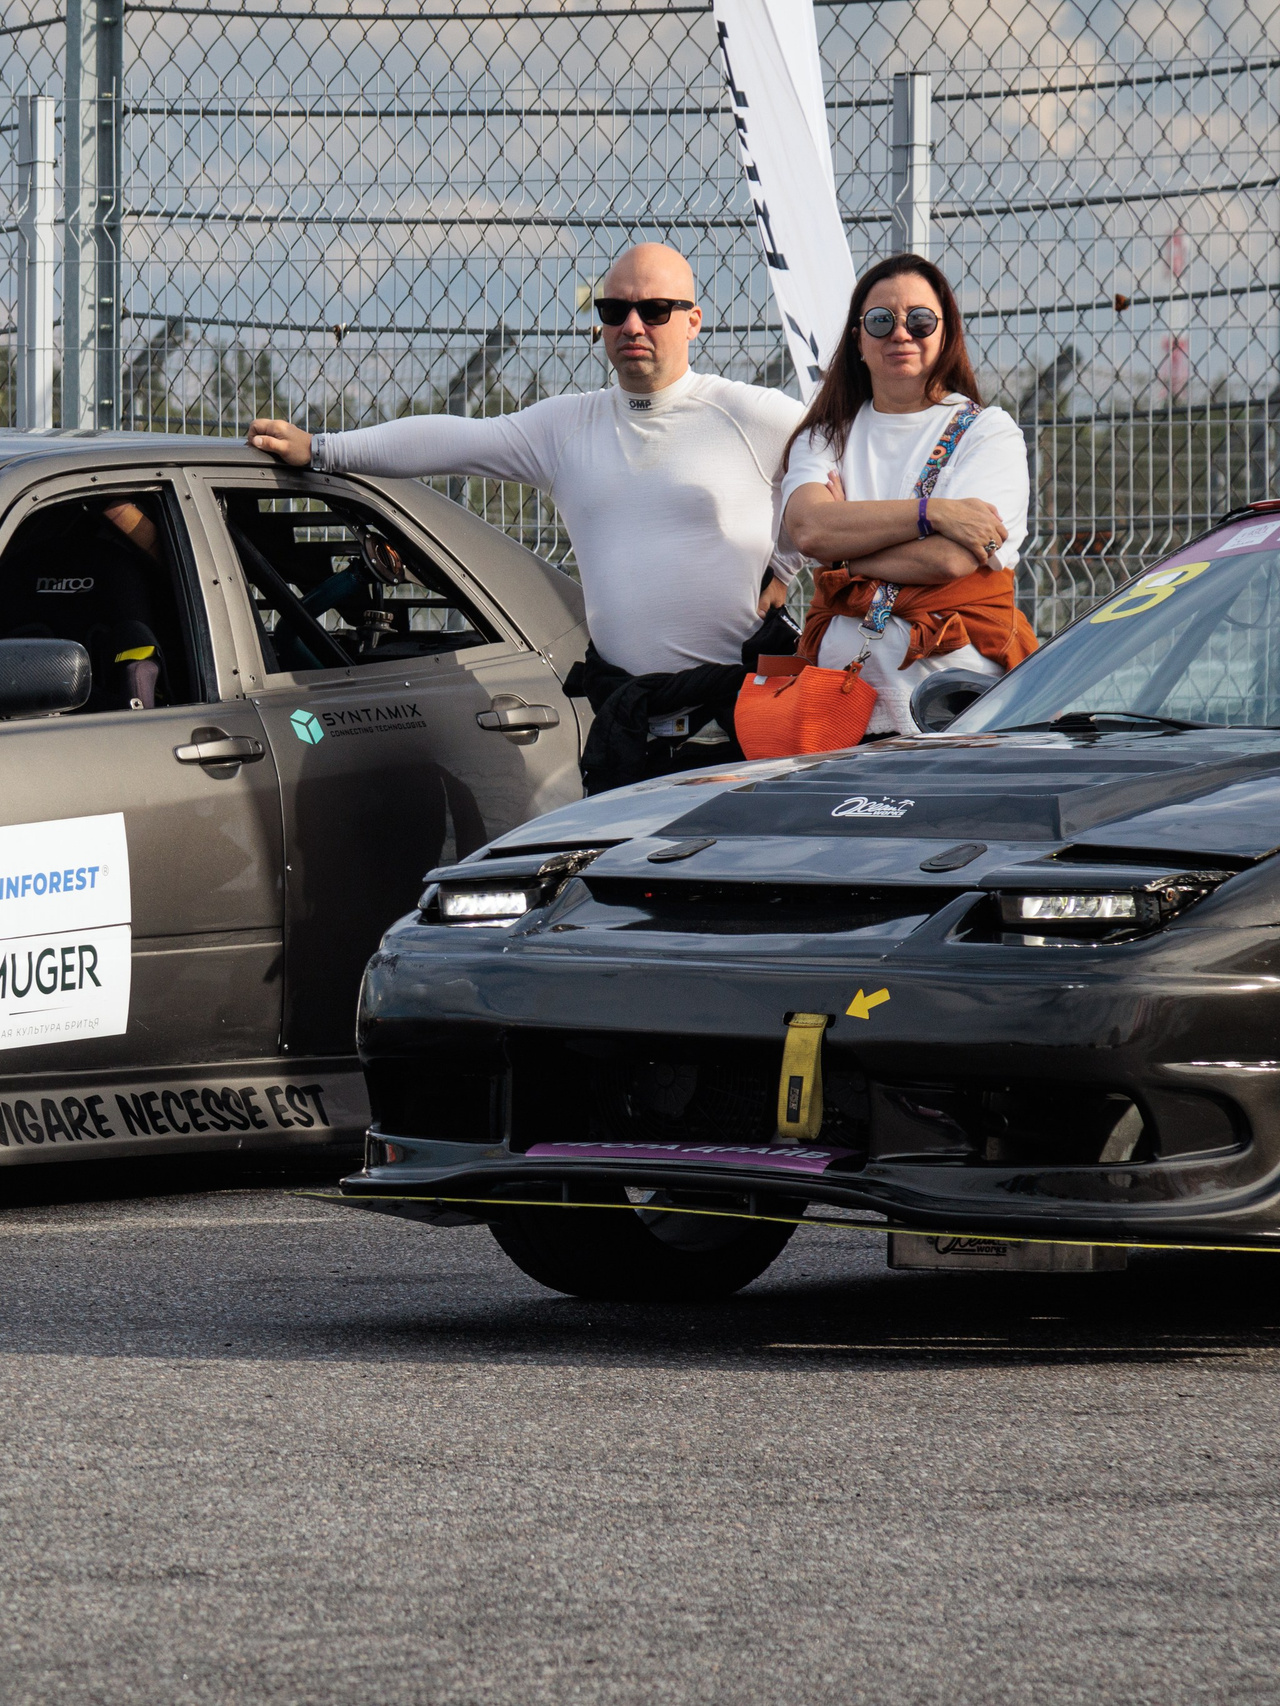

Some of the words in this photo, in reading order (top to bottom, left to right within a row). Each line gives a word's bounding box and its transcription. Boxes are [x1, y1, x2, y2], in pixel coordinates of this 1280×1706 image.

[629, 400, 651, 409] OMP
[1090, 562, 1210, 623] 8
[322, 703, 422, 727] SYNTAMIX
[330, 726, 374, 738] CONNECTING
[375, 720, 427, 733] TECHNOLOGIES
[17, 1023, 61, 1037] КУЛЬТУРА
[65, 1018, 99, 1031] БРИТЬЯ
[115, 1086, 269, 1137] NECESSE
[264, 1084, 331, 1128] EST
[681, 1146, 831, 1160] ДРАЙВ
